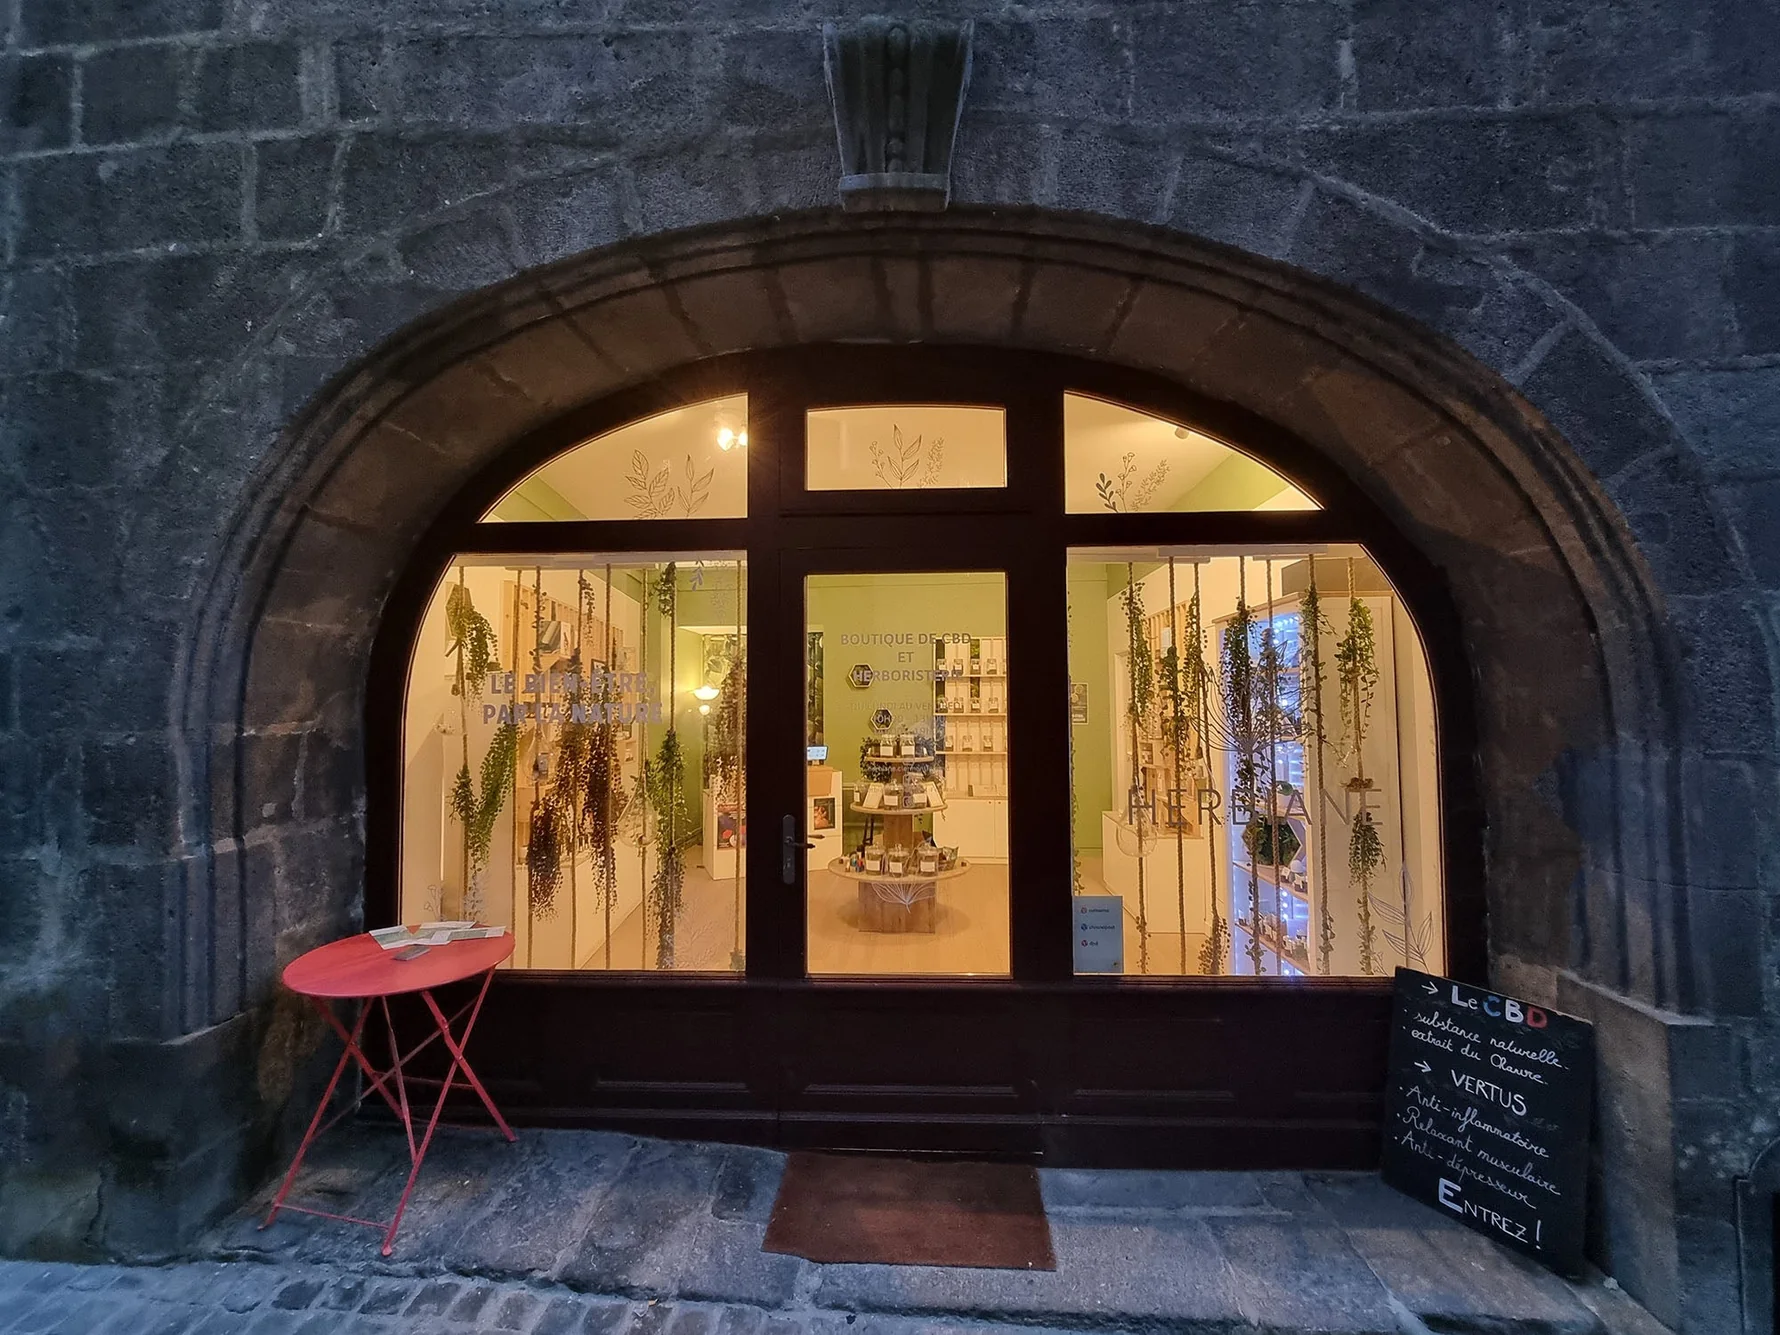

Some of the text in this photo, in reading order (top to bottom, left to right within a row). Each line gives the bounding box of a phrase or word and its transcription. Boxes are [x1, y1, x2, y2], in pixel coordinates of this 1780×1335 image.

[841, 633, 971, 647] BOUTIQUE DE CBD
[898, 652, 914, 663] ET
[491, 673, 514, 694] LE
[484, 703, 662, 724] PAR LA NATURE
[1451, 985, 1548, 1028] Le CBD
[1413, 1011, 1481, 1043] substance
[1412, 1029, 1453, 1052] extrait
[1461, 1044, 1481, 1060] du
[1451, 1069, 1527, 1116] VERTUS
[1406, 1085, 1549, 1158] Anti-inflammatoire
[1403, 1106, 1561, 1195] Relaxant musculaire
[1401, 1130, 1536, 1209] Anti-dépresseur
